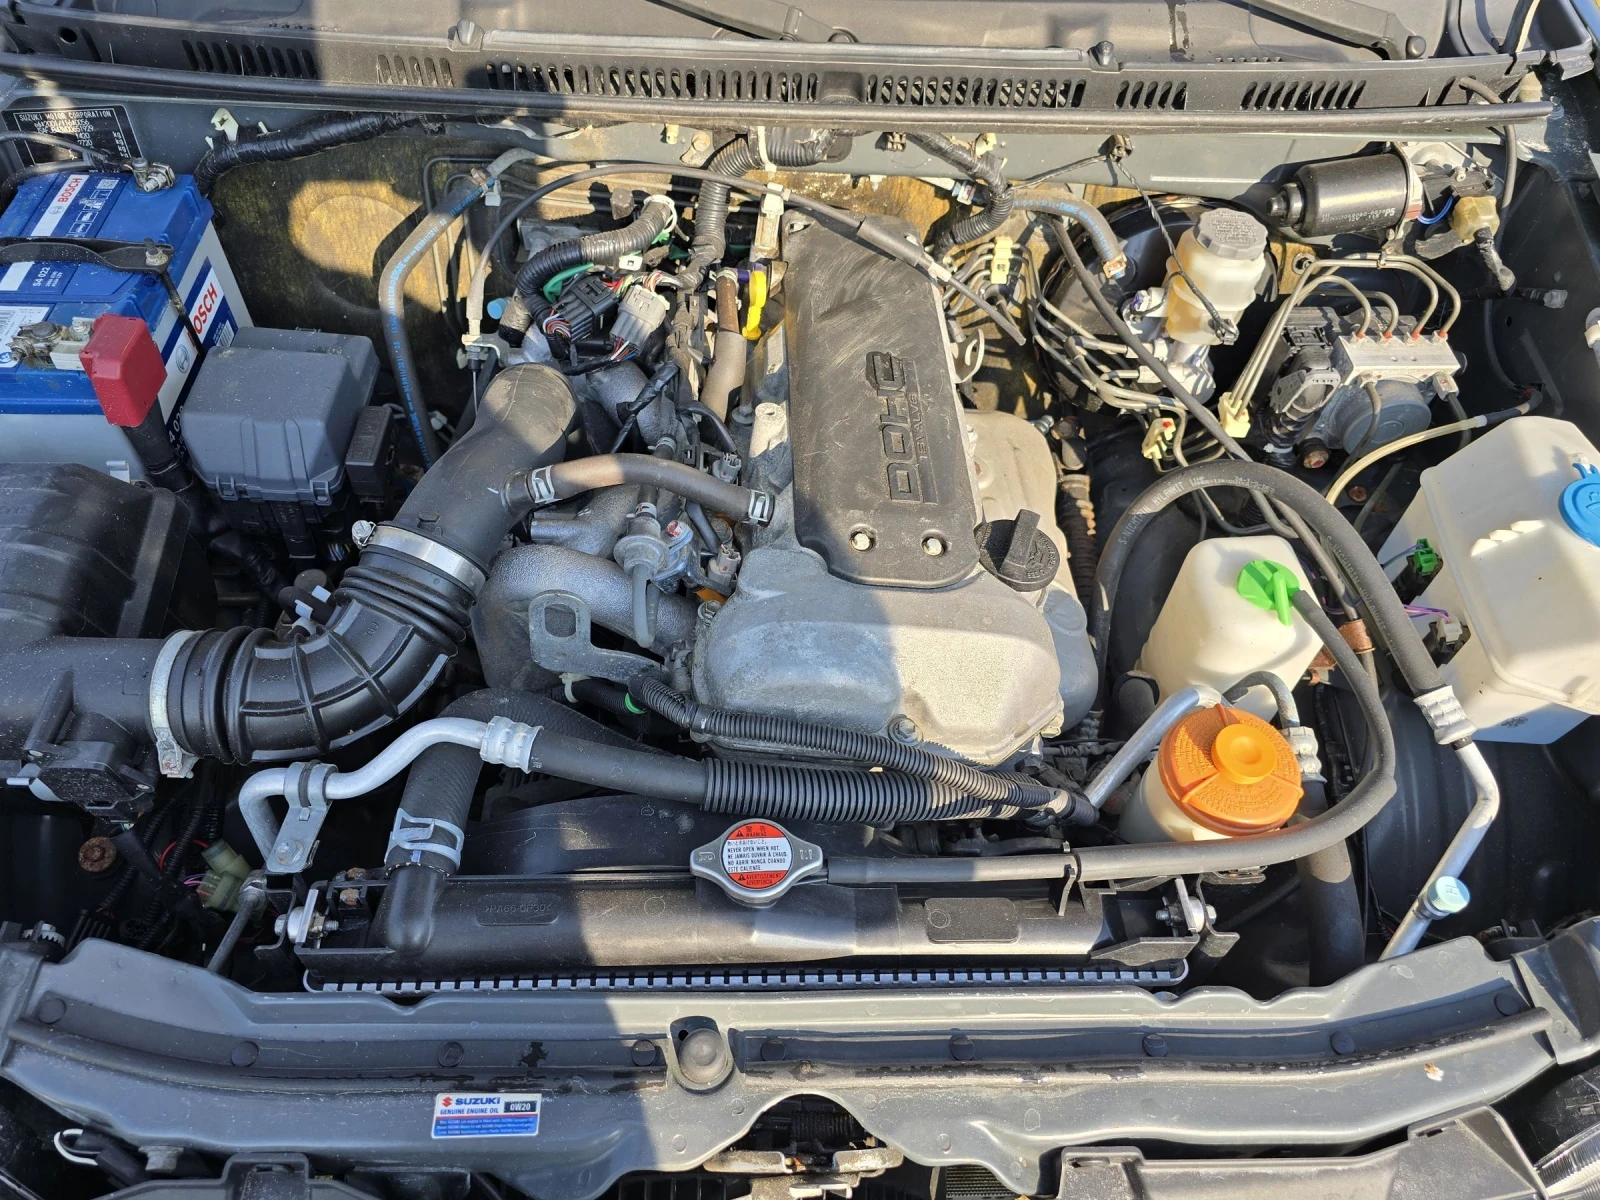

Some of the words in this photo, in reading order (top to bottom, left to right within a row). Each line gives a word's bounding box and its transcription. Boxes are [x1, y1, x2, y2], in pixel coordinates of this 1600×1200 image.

[19, 113, 43, 122] SUZUKI
[45, 112, 67, 120] MOTOR
[68, 110, 112, 120] CORPORATION
[112, 130, 122, 138] kg
[57, 177, 82, 203] BOSCH
[37, 266, 51, 278] 022
[187, 282, 218, 348] OSCH
[867, 351, 923, 503] DOHC
[455, 1096, 501, 1106] SUZUKI
[509, 1102, 531, 1111] 0W20
